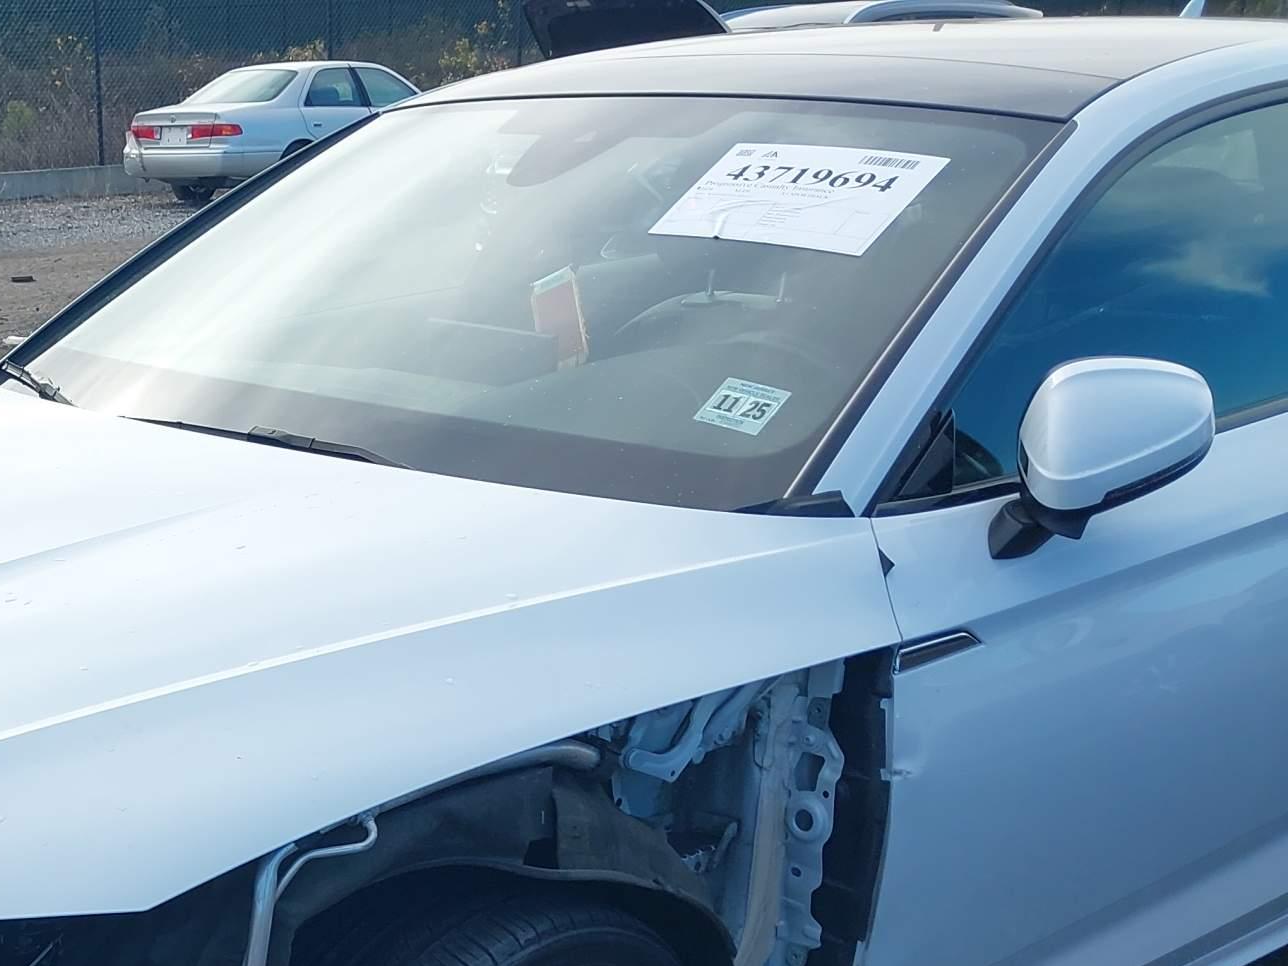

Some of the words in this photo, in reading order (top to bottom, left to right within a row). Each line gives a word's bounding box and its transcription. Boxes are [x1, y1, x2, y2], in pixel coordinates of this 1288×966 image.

[726, 164, 900, 192] 43719694
[713, 394, 743, 413] 11
[739, 401, 771, 420] 25
